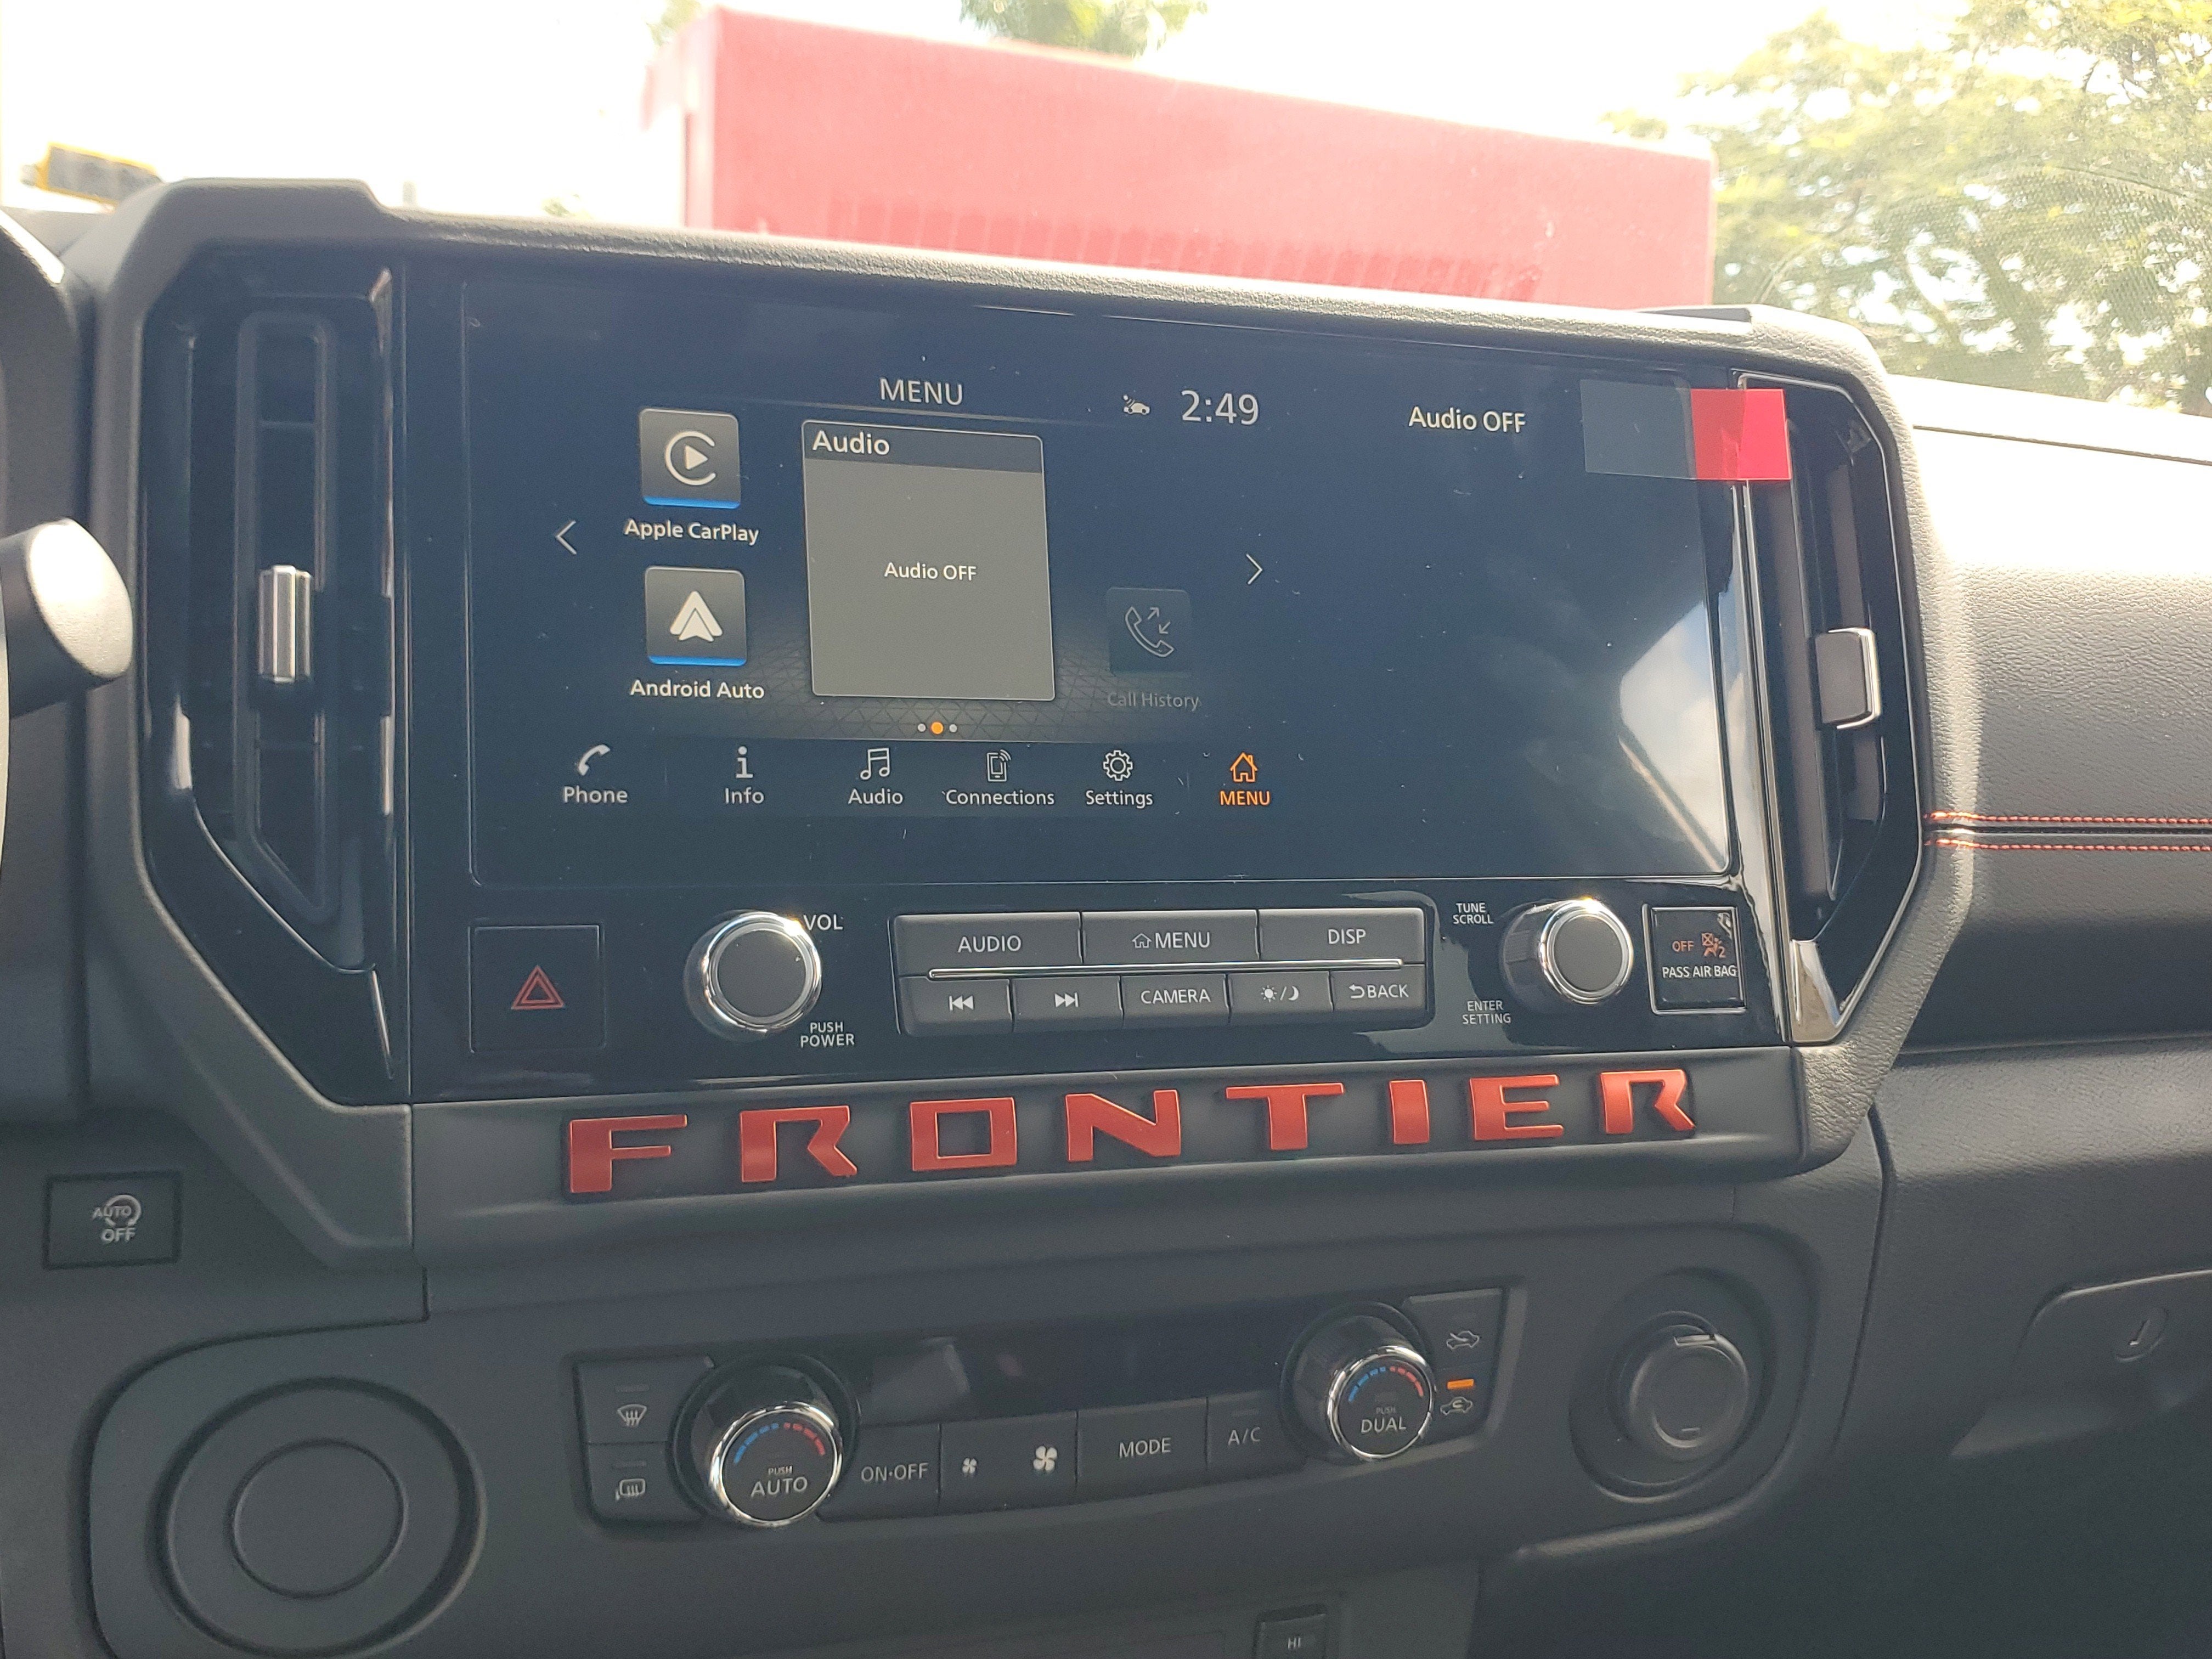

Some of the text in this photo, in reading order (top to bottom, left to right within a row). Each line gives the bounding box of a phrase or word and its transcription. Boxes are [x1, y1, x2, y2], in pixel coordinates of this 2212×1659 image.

[879, 377, 964, 406] MENU
[1181, 389, 1260, 426] 2:49
[1408, 405, 1527, 433] Audio OFF
[811, 430, 890, 455] Audio
[624, 518, 760, 546] Apple CarPlay
[884, 561, 978, 582] Audio OFF
[630, 679, 765, 700] Android Auto
[1107, 691, 1200, 710] Call History
[562, 786, 628, 805] Phone
[724, 787, 765, 805] Info
[848, 788, 903, 805] Audio
[946, 789, 1055, 806] Connections
[1085, 790, 1153, 810] Settings
[1220, 790, 1271, 806] MENU
[1455, 902, 1486, 914] TUNE
[803, 913, 843, 932] VOL
[1453, 914, 1494, 926] SCROLL
[957, 934, 1022, 953] AUDIO
[1154, 931, 1211, 950] MENU
[1328, 928, 1367, 945] DISP
[1672, 940, 1694, 952] OFF
[1662, 964, 1738, 979] PASS AIR BAG
[1141, 989, 1211, 1005] CAMERA
[1367, 984, 1409, 1000] BACK
[1466, 1000, 1504, 1012] ENTER
[1462, 1012, 1511, 1025] SETTING
[810, 1022, 844, 1034] PUSH
[800, 1034, 855, 1048] POWER
[568, 1068, 1696, 1194] FRONTIER
[91, 1206, 132, 1221] AUTO
[101, 1227, 136, 1243] OFF
[1376, 1406, 1396, 1415] PUSH
[1360, 1417, 1407, 1434] DUAL
[1228, 1426, 1261, 1447] A/C
[1119, 1437, 1172, 1458] MODE
[768, 1465, 793, 1476] PUSH
[750, 1476, 808, 1499] AUTO
[1288, 1637, 1301, 1650] HI
